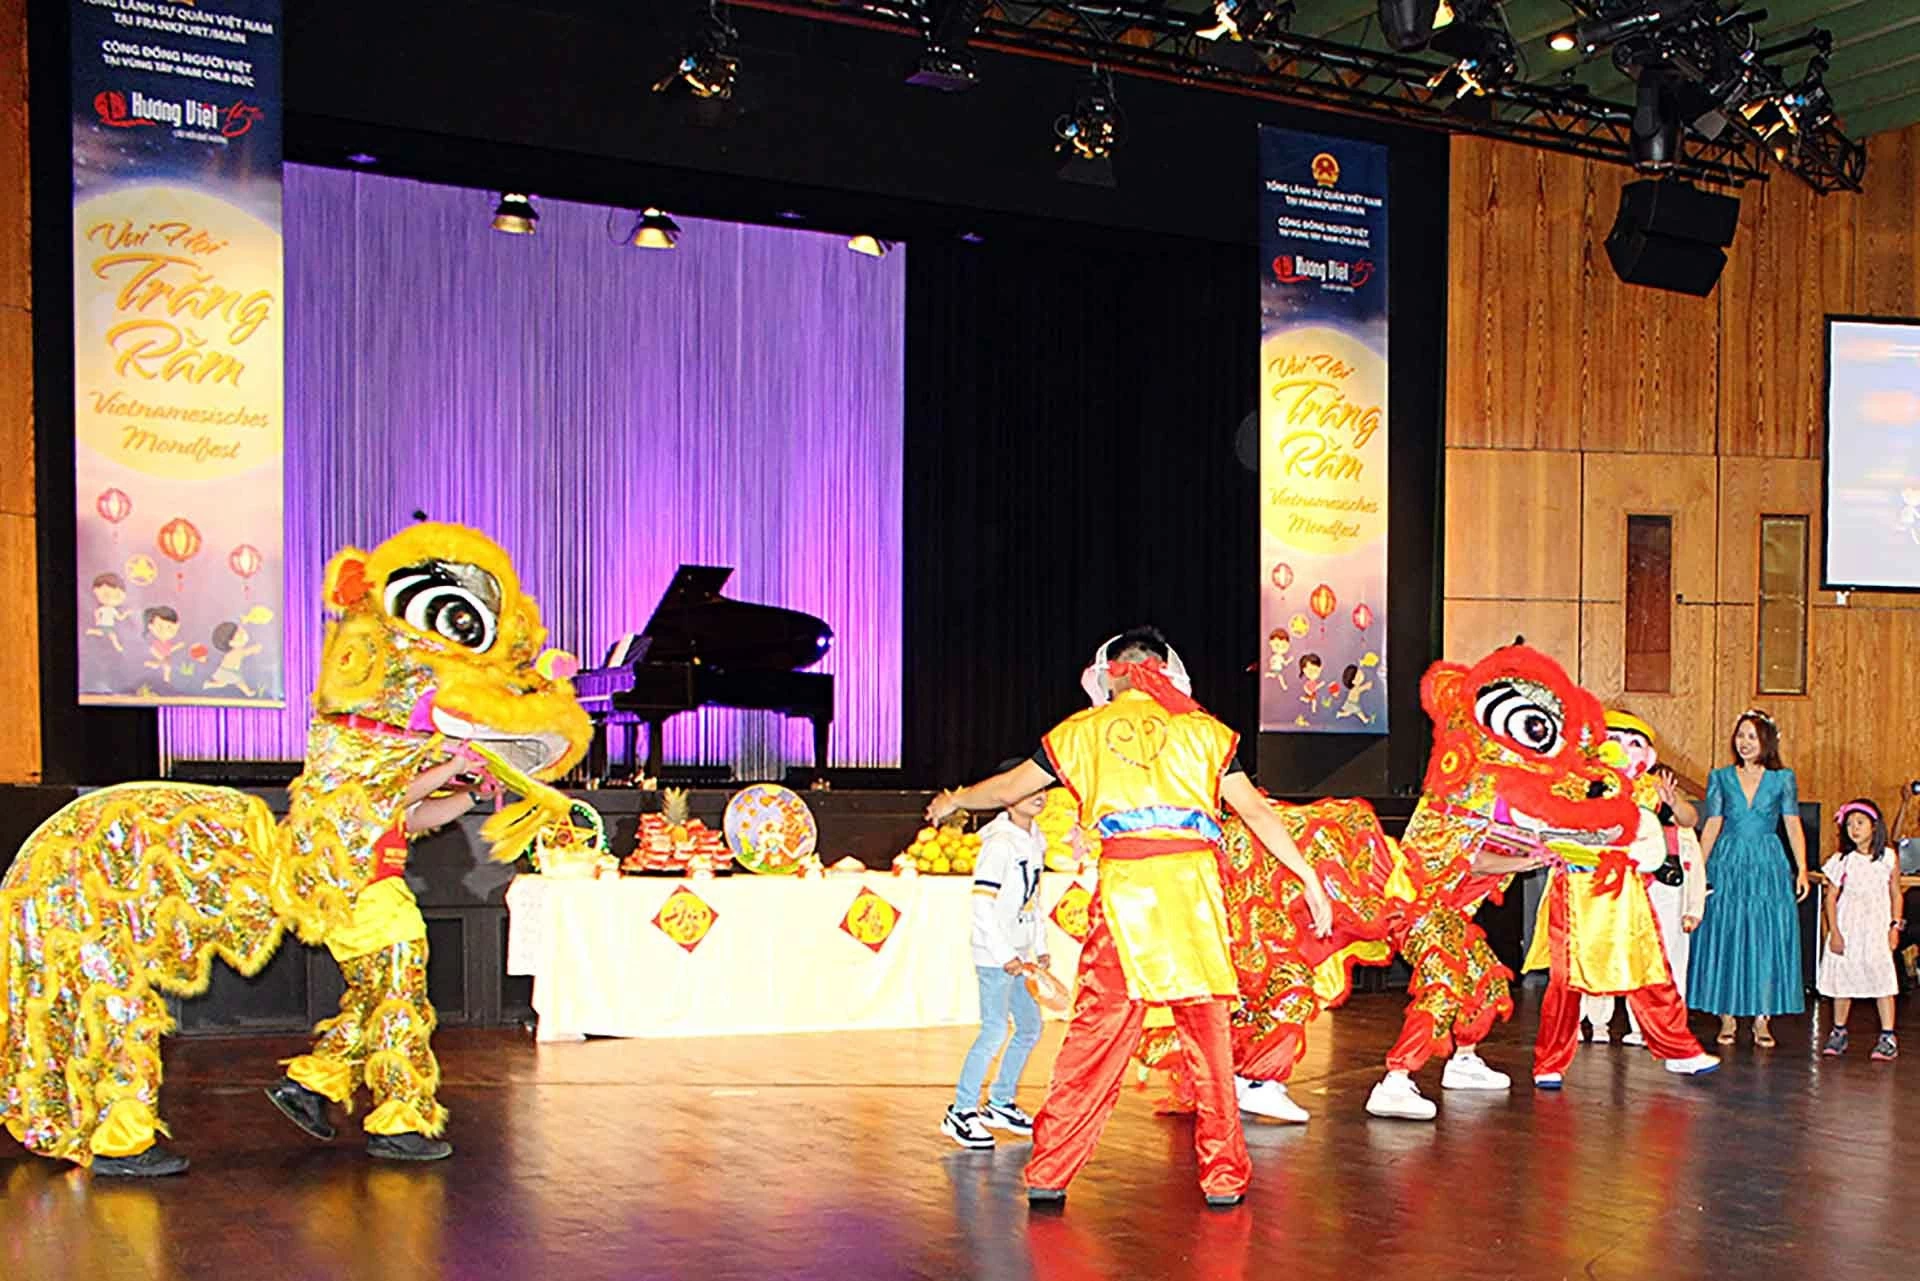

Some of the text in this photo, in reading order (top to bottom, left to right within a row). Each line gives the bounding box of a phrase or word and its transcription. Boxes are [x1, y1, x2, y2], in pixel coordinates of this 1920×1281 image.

[112, 12, 247, 44] TẠI FRANKFURT/MAIN
[244, 19, 273, 34] NAM
[102, 40, 140, 55] CỘNG
[91, 252, 275, 346] Trăng
[88, 390, 270, 428] Vietnamesisches
[122, 425, 241, 463] Mondfest
